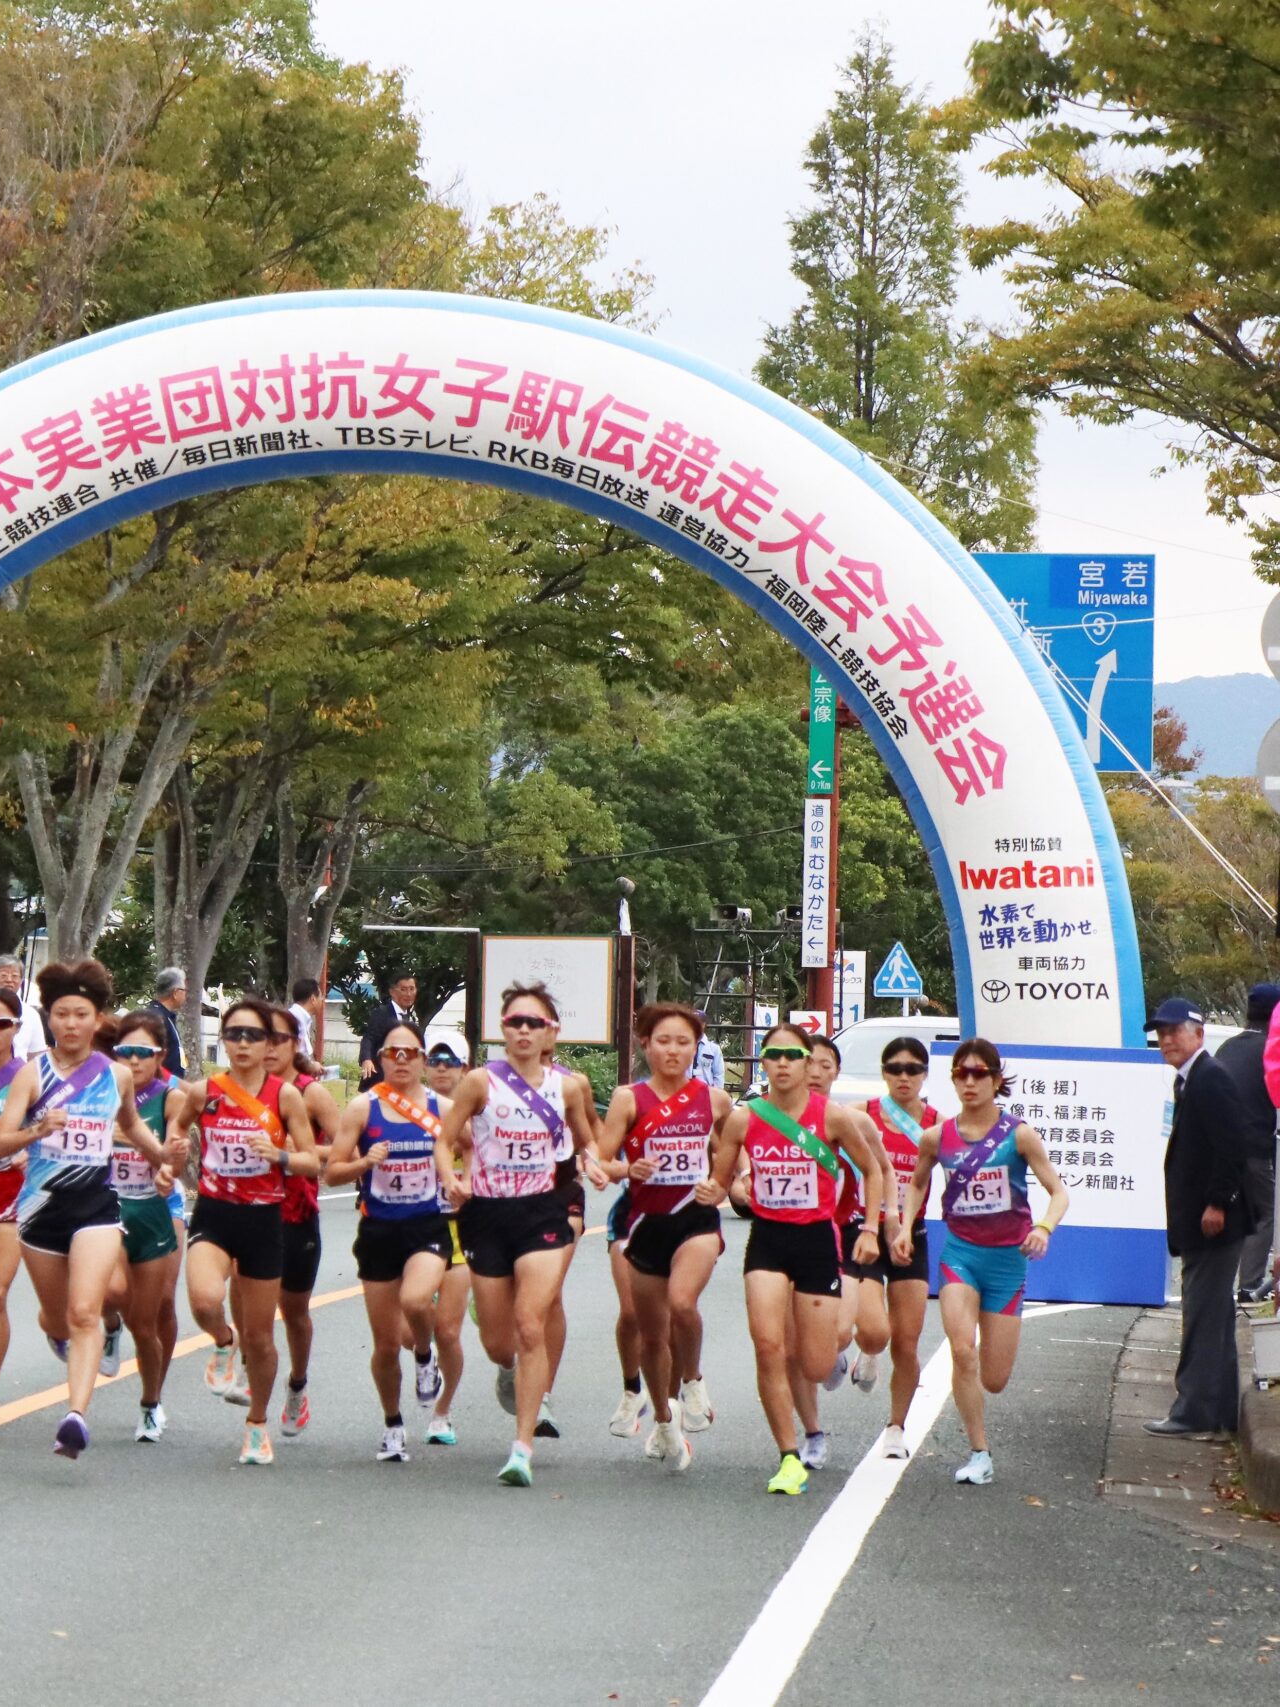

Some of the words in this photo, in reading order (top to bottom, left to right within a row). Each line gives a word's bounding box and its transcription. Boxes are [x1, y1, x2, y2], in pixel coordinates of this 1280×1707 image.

[1078, 590, 1148, 607] Miyawaka
[1092, 618, 1106, 635] 3
[994, 837, 1062, 853] 特別協賛
[959, 858, 1095, 890] Iwatani
[978, 903, 1036, 927] 水素で
[1018, 956, 1086, 971] 車両協力
[1015, 982, 1110, 1001] TOYOTA
[660, 1123, 705, 1134] WACOAL
[61, 1131, 103, 1152] 19-1
[649, 1138, 705, 1151] Iwatani
[505, 1142, 546, 1161] 15-1
[659, 1153, 703, 1172] 28-1
[764, 1177, 809, 1196] 17-1
